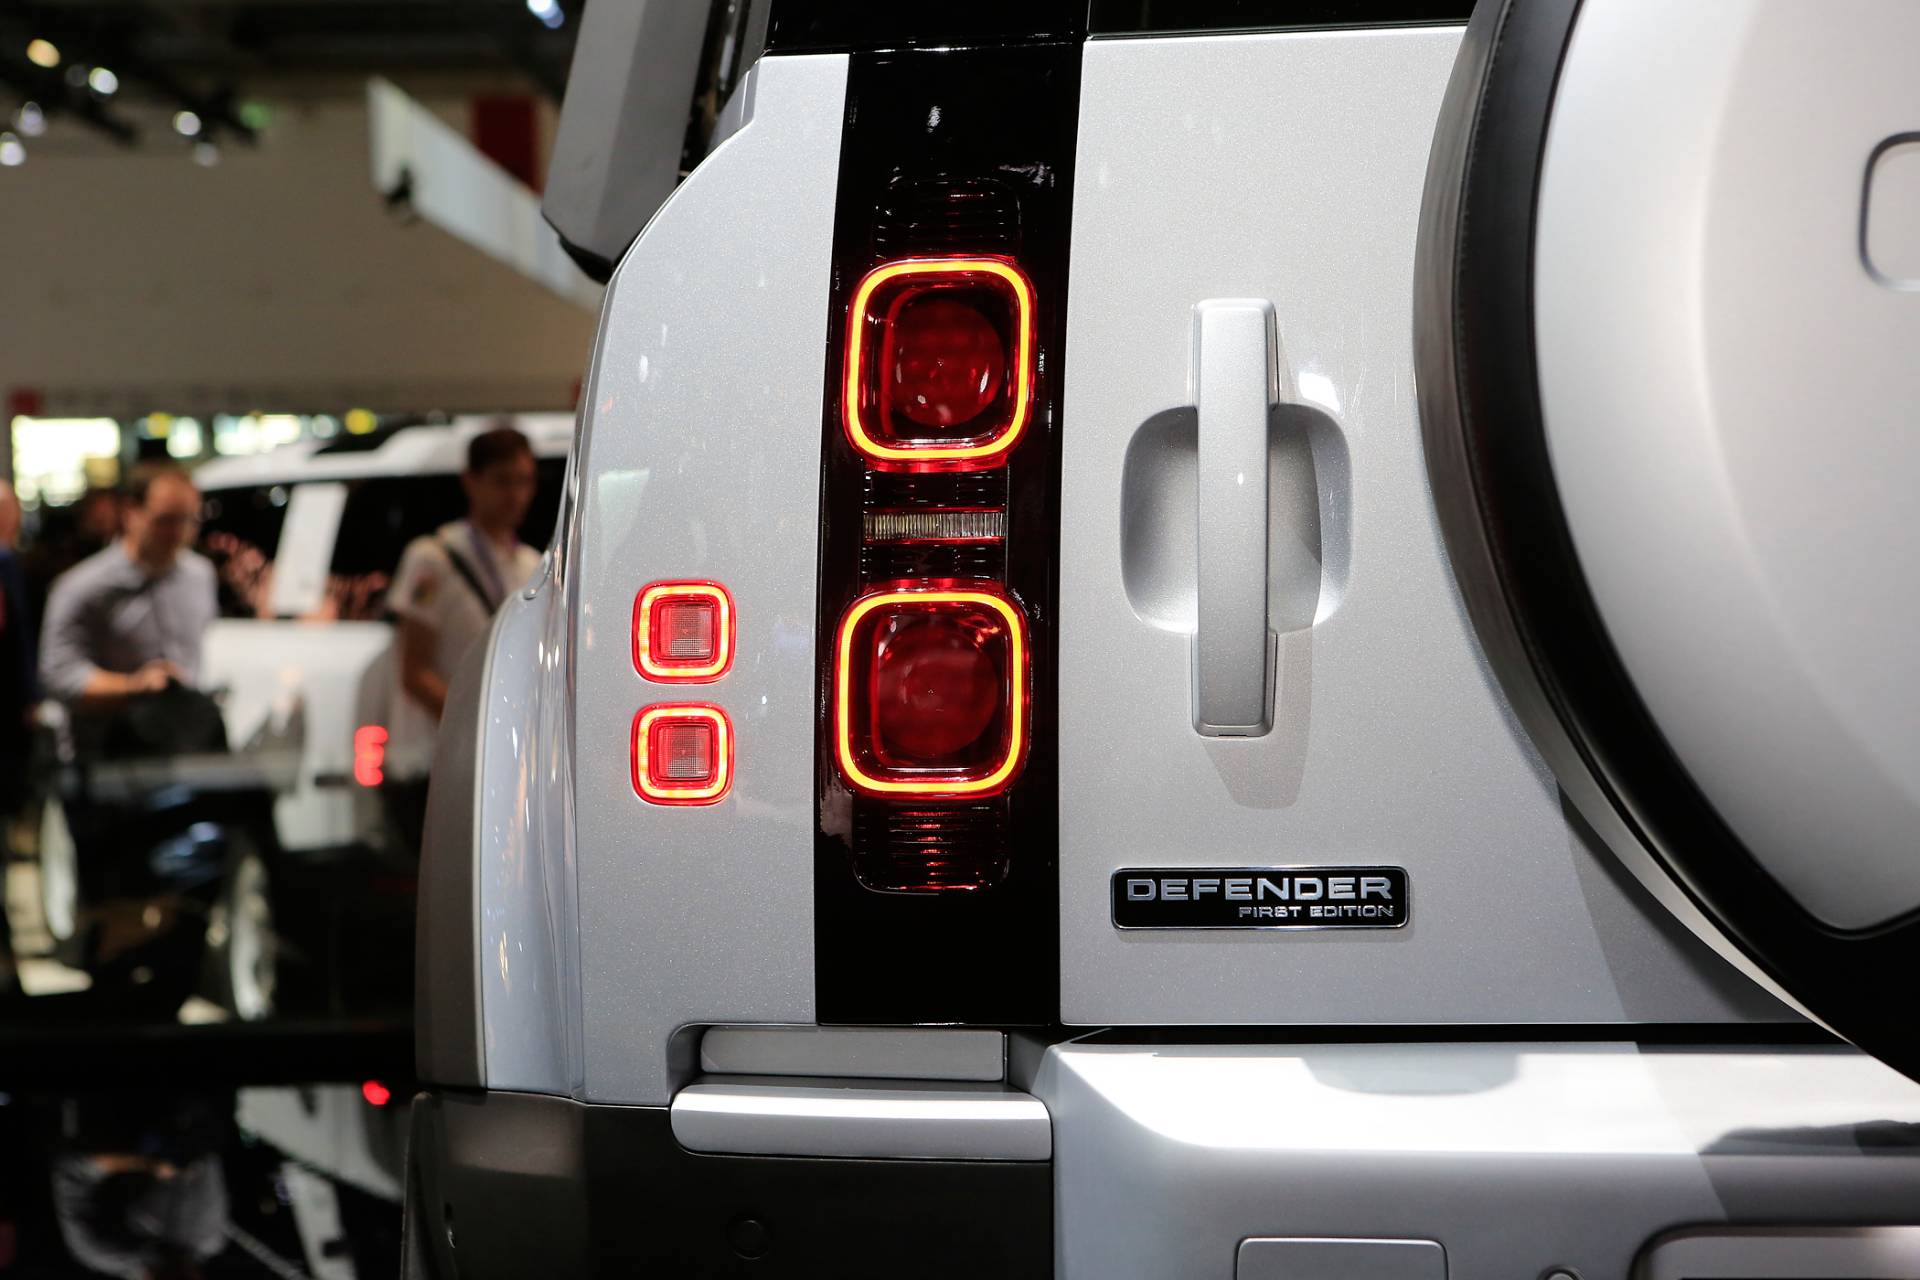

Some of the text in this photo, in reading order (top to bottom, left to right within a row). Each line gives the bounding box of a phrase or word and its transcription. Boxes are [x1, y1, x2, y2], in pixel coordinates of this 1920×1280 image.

[1126, 877, 1393, 901] DEFENDER
[1238, 905, 1394, 918] FIRST EDITION
